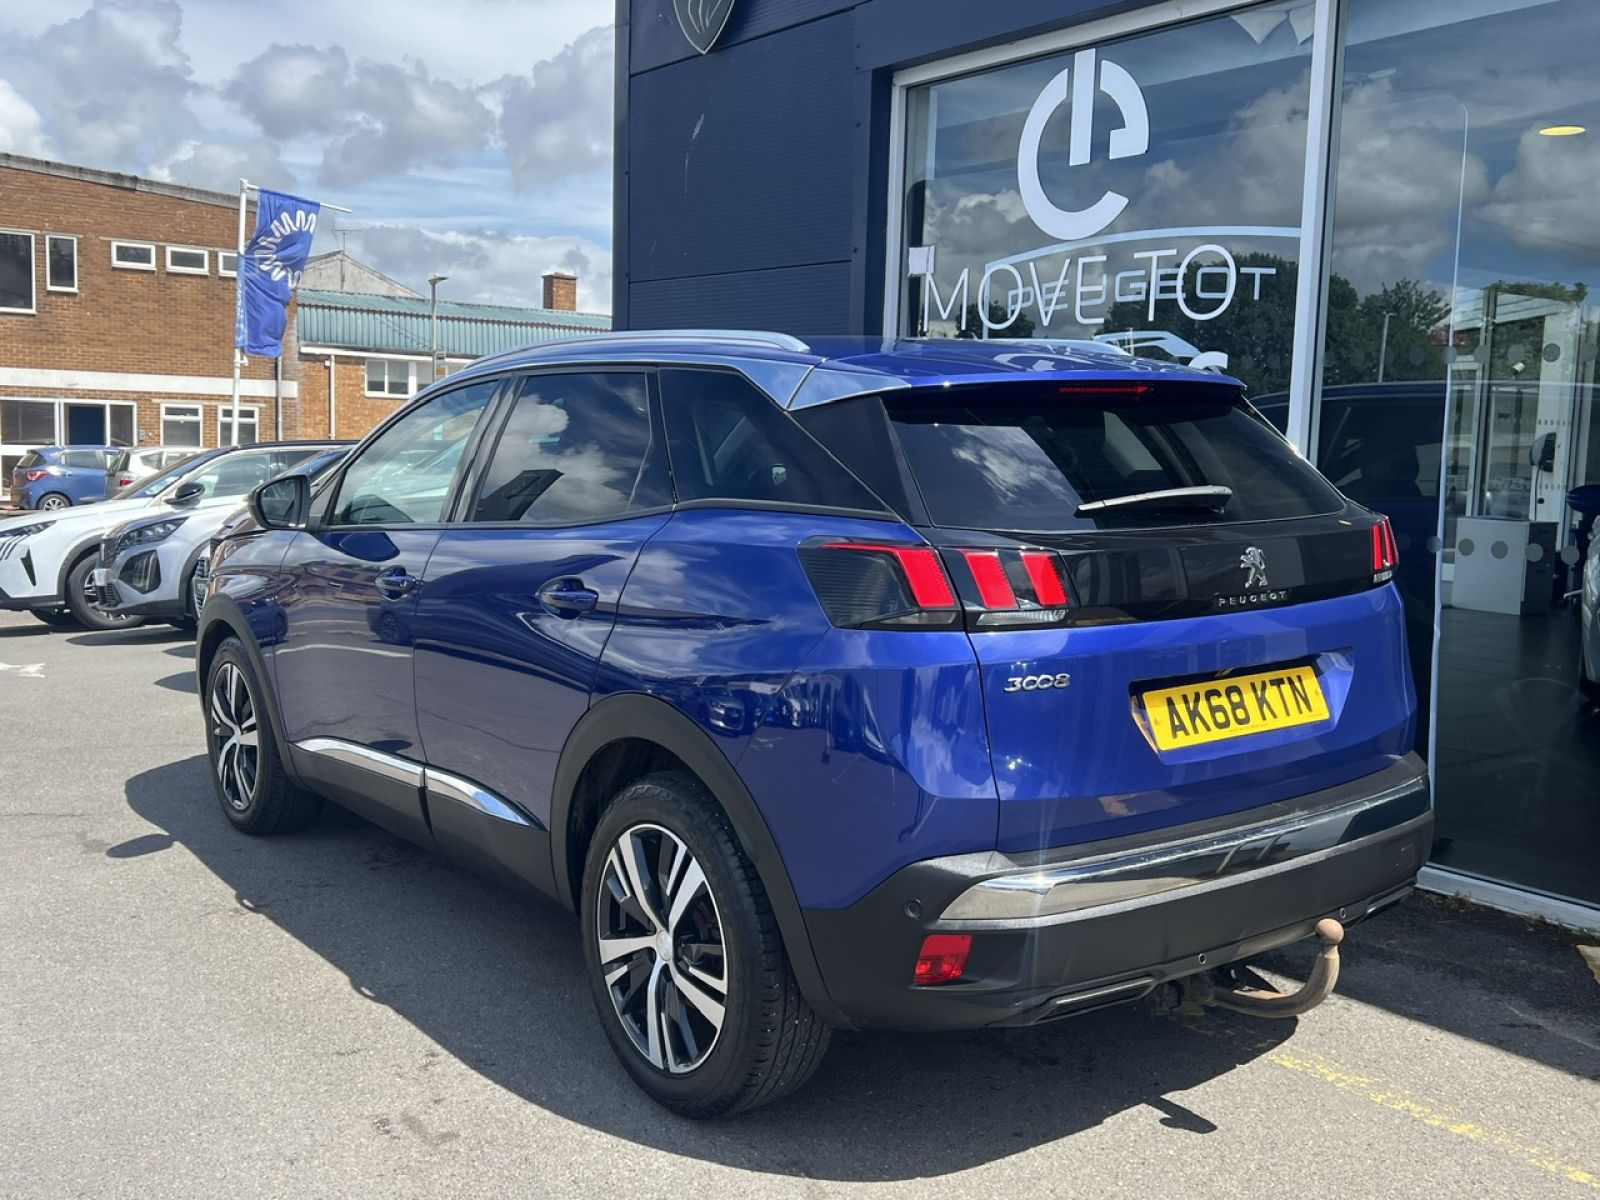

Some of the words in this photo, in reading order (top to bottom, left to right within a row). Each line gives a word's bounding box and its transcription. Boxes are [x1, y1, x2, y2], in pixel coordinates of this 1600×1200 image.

[923, 255, 1108, 332] MOVE
[1133, 244, 1237, 322] TO
[1218, 590, 1287, 608] PEUGEOT
[1004, 673, 1071, 692] 3008
[1165, 684, 1251, 740] AK68
[1249, 674, 1313, 722] KTN
